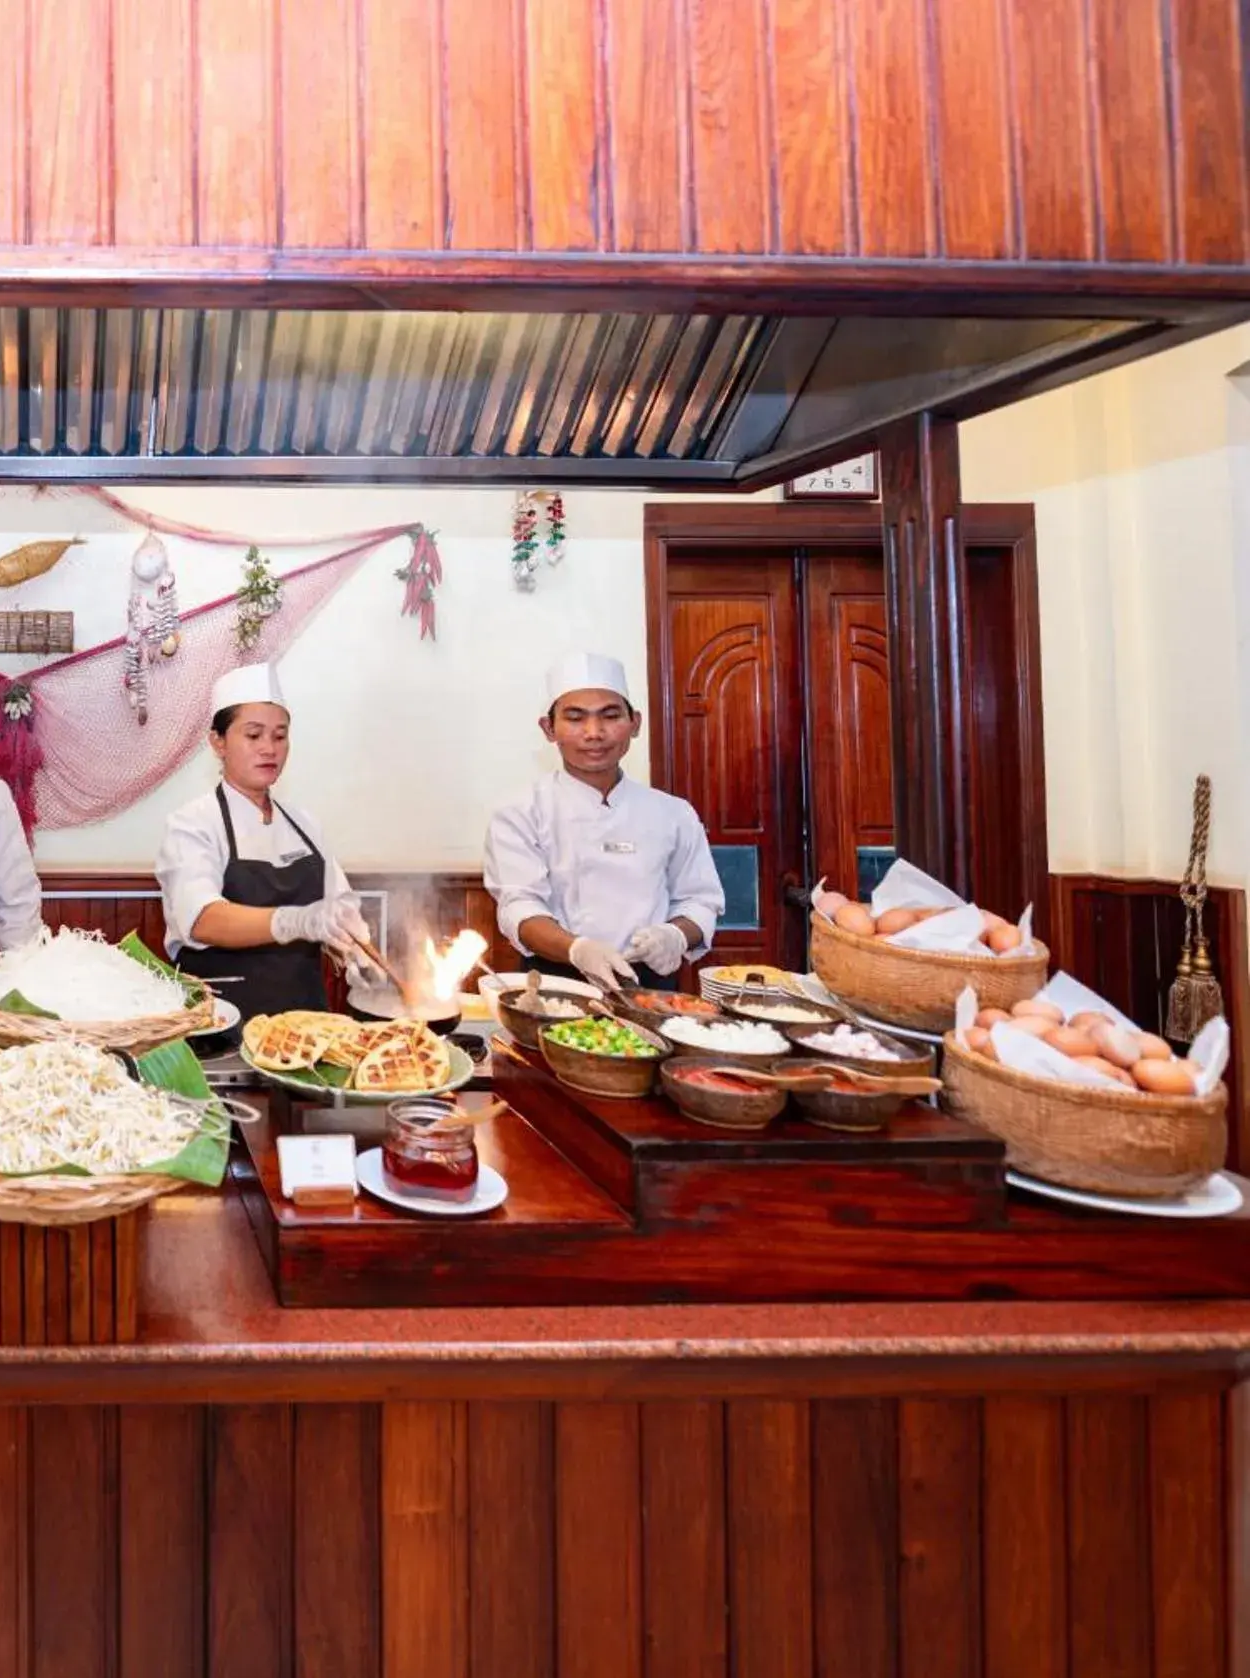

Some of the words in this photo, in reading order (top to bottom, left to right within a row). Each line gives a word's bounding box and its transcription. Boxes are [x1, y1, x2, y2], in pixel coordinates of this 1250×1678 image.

[853, 466, 862, 475] 4
[809, 478, 817, 488] 7
[824, 478, 834, 488] 6
[841, 478, 851, 488] 5
